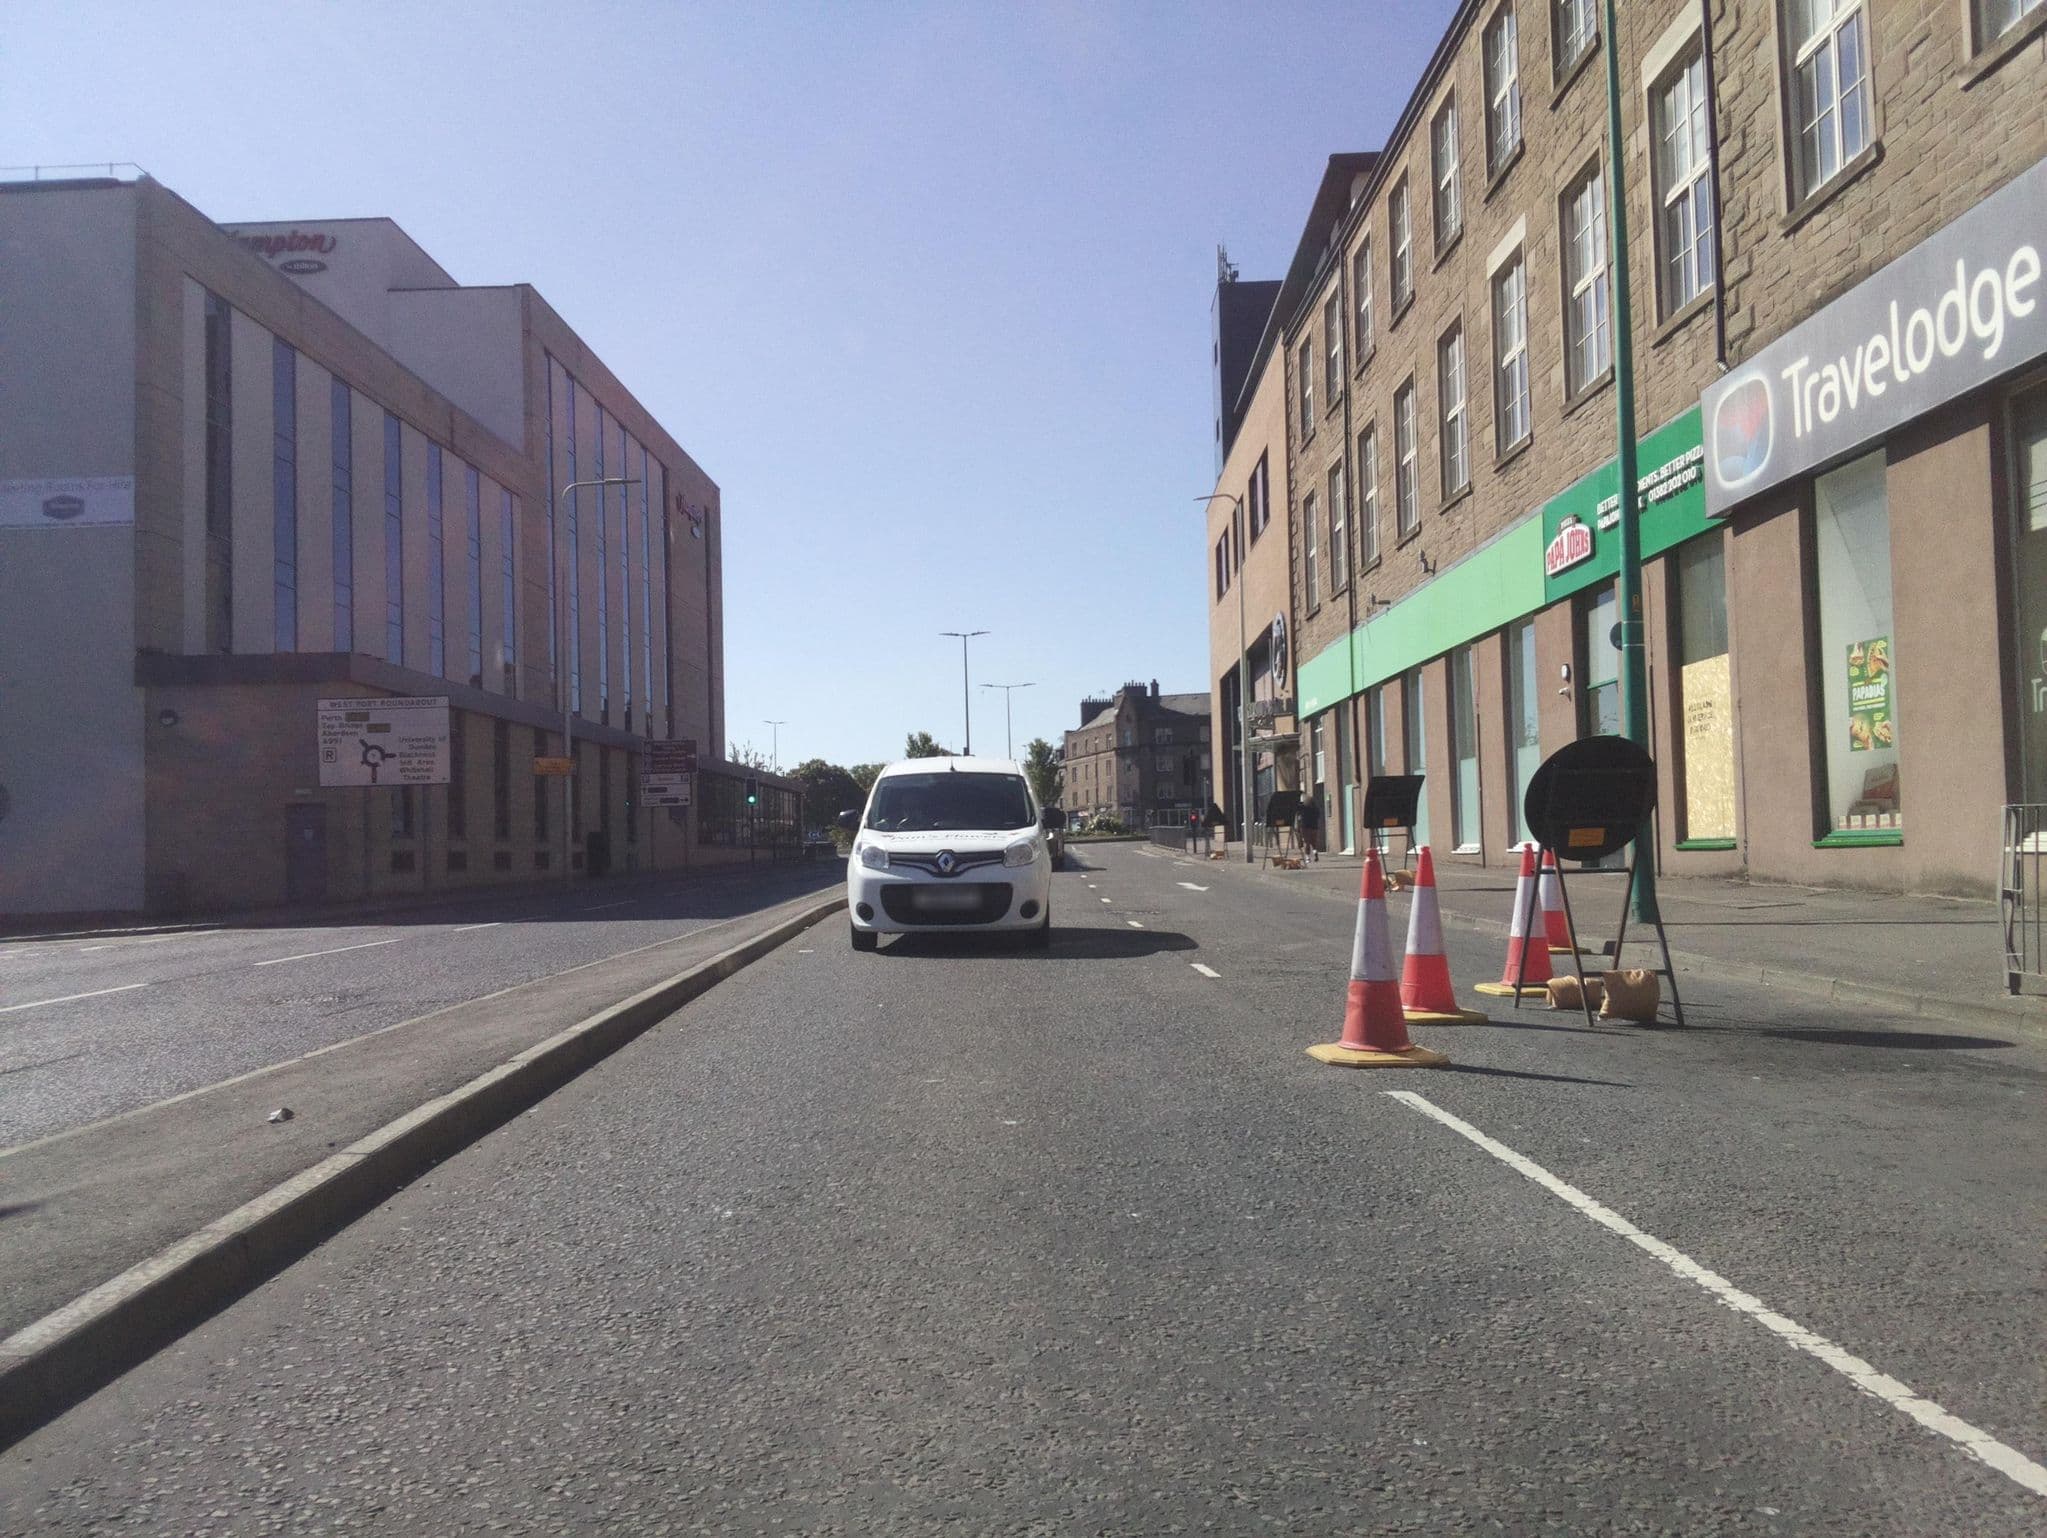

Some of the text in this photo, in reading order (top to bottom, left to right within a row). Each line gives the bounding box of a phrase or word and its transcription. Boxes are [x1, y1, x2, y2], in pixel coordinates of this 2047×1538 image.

[1781, 245, 2041, 438] Travelodge
[1659, 453, 1685, 481] BETTER
[1667, 474, 1682, 492] 202
[1682, 466, 1697, 483] 010
[1547, 528, 1589, 574] PAPA JOHNS
[330, 698, 437, 708] WEST PORT ROUNDABOUT
[399, 736, 436, 744] University
[325, 750, 335, 760] R
